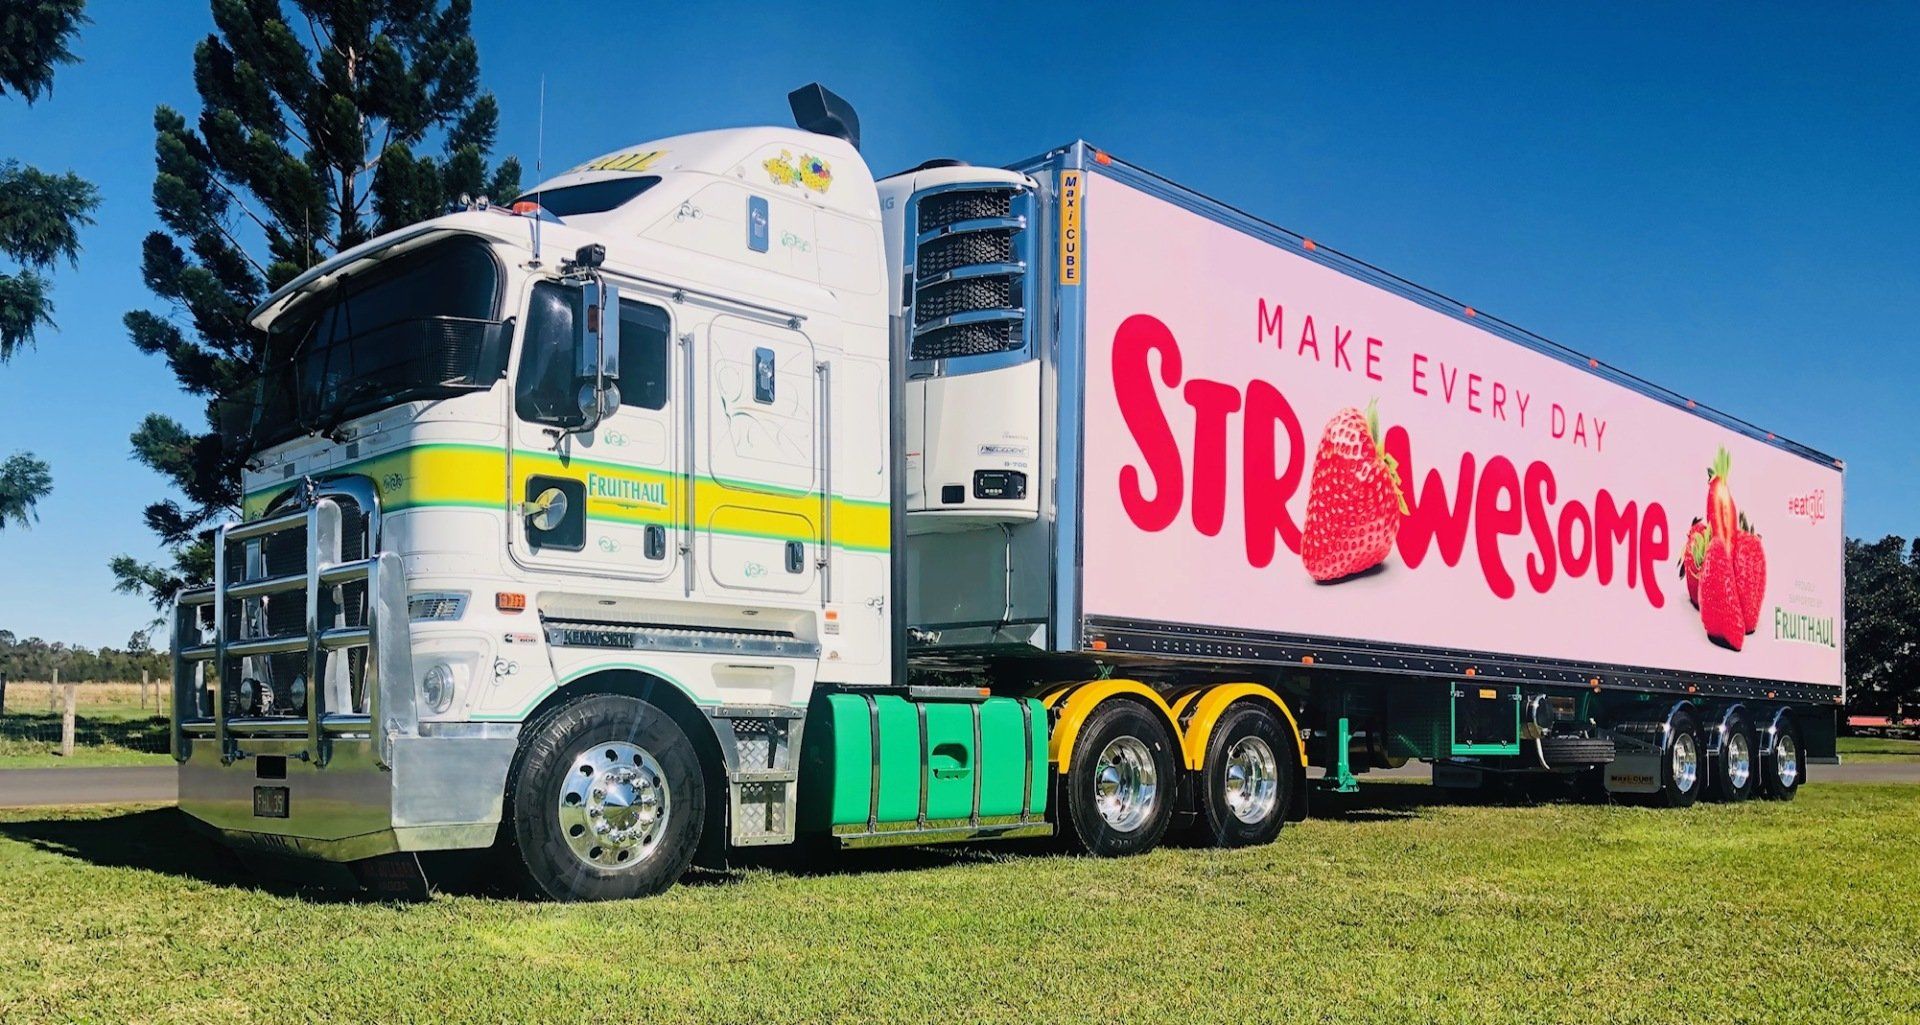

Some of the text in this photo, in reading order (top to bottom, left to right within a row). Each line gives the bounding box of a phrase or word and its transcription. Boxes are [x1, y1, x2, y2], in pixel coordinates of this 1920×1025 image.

[1257, 297, 1608, 452] MAKE EVERY DAY
[588, 472, 668, 506] FRUITHAUL
[561, 629, 634, 648] KENWORTH
[1774, 606, 1836, 648] FRUITHAUL
